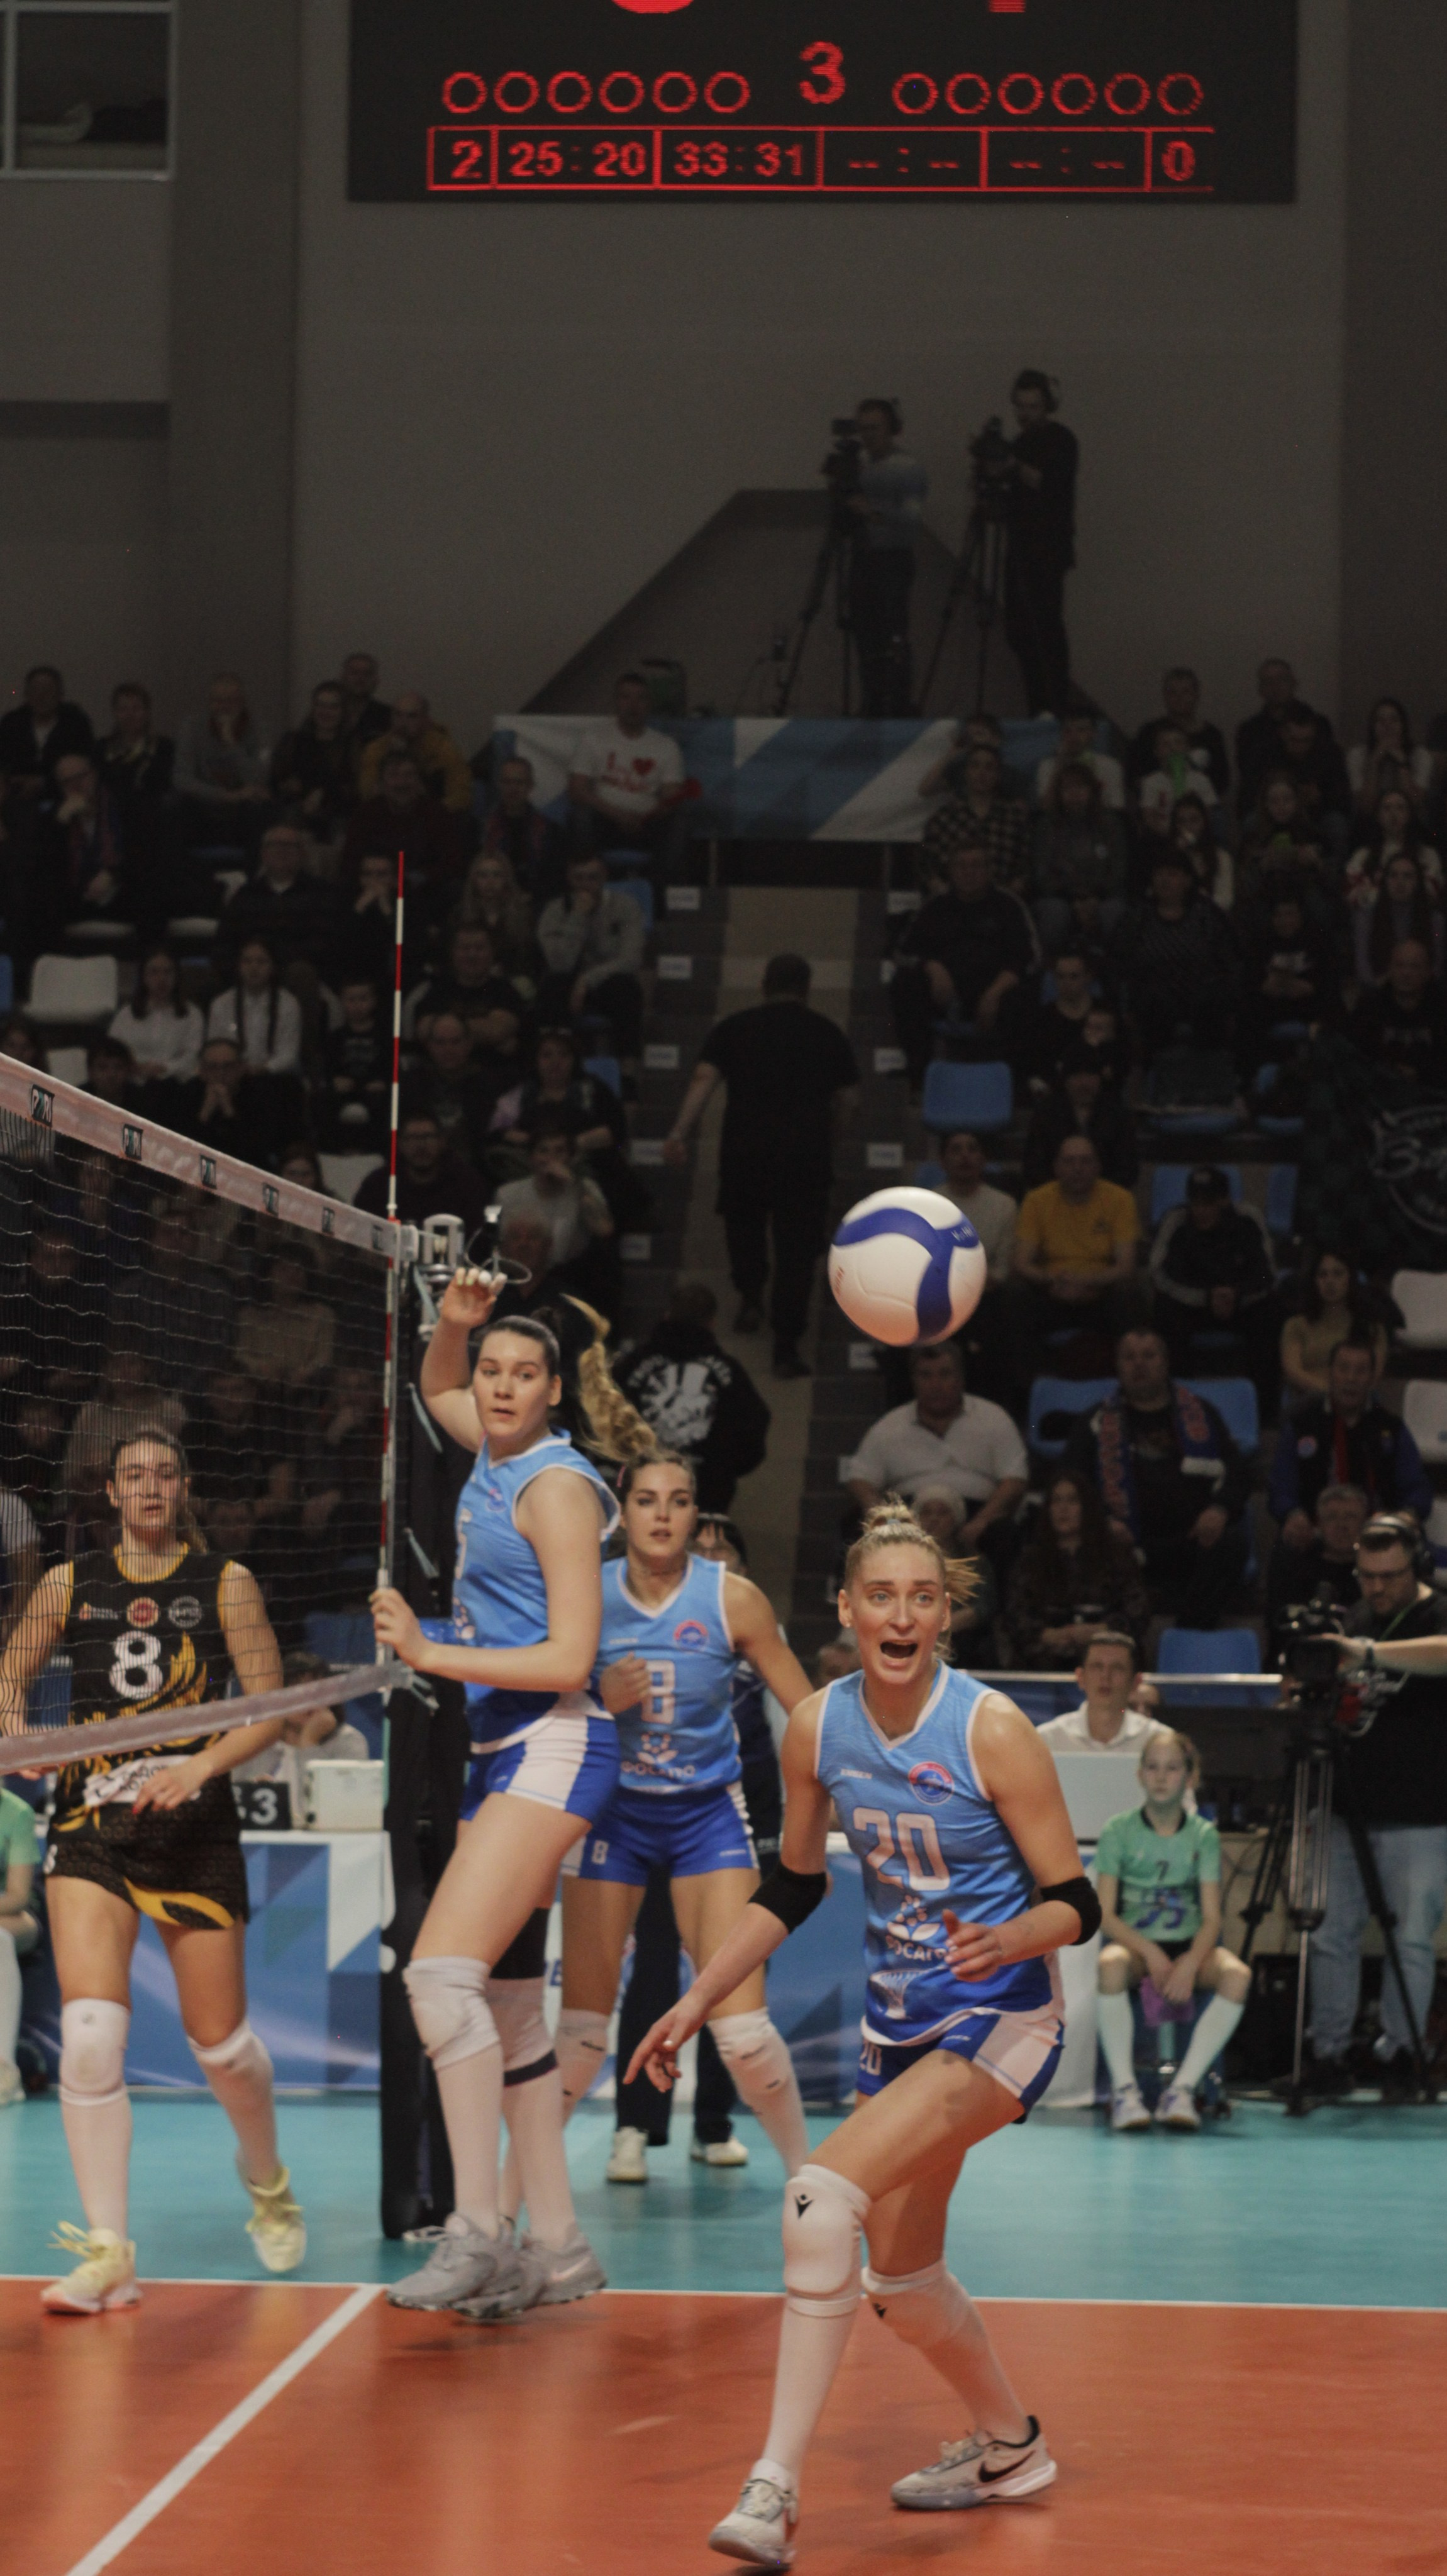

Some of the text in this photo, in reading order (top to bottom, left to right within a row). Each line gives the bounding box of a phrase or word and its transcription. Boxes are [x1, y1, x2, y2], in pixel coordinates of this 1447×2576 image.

[799, 41, 845, 104] 3
[451, 140, 483, 179] 2
[1161, 140, 1196, 181] 0
[109, 1631, 163, 1699] 8
[641, 1660, 675, 1724] 8
[591, 1840, 609, 1865] 8
[853, 1807, 950, 1891] 20
